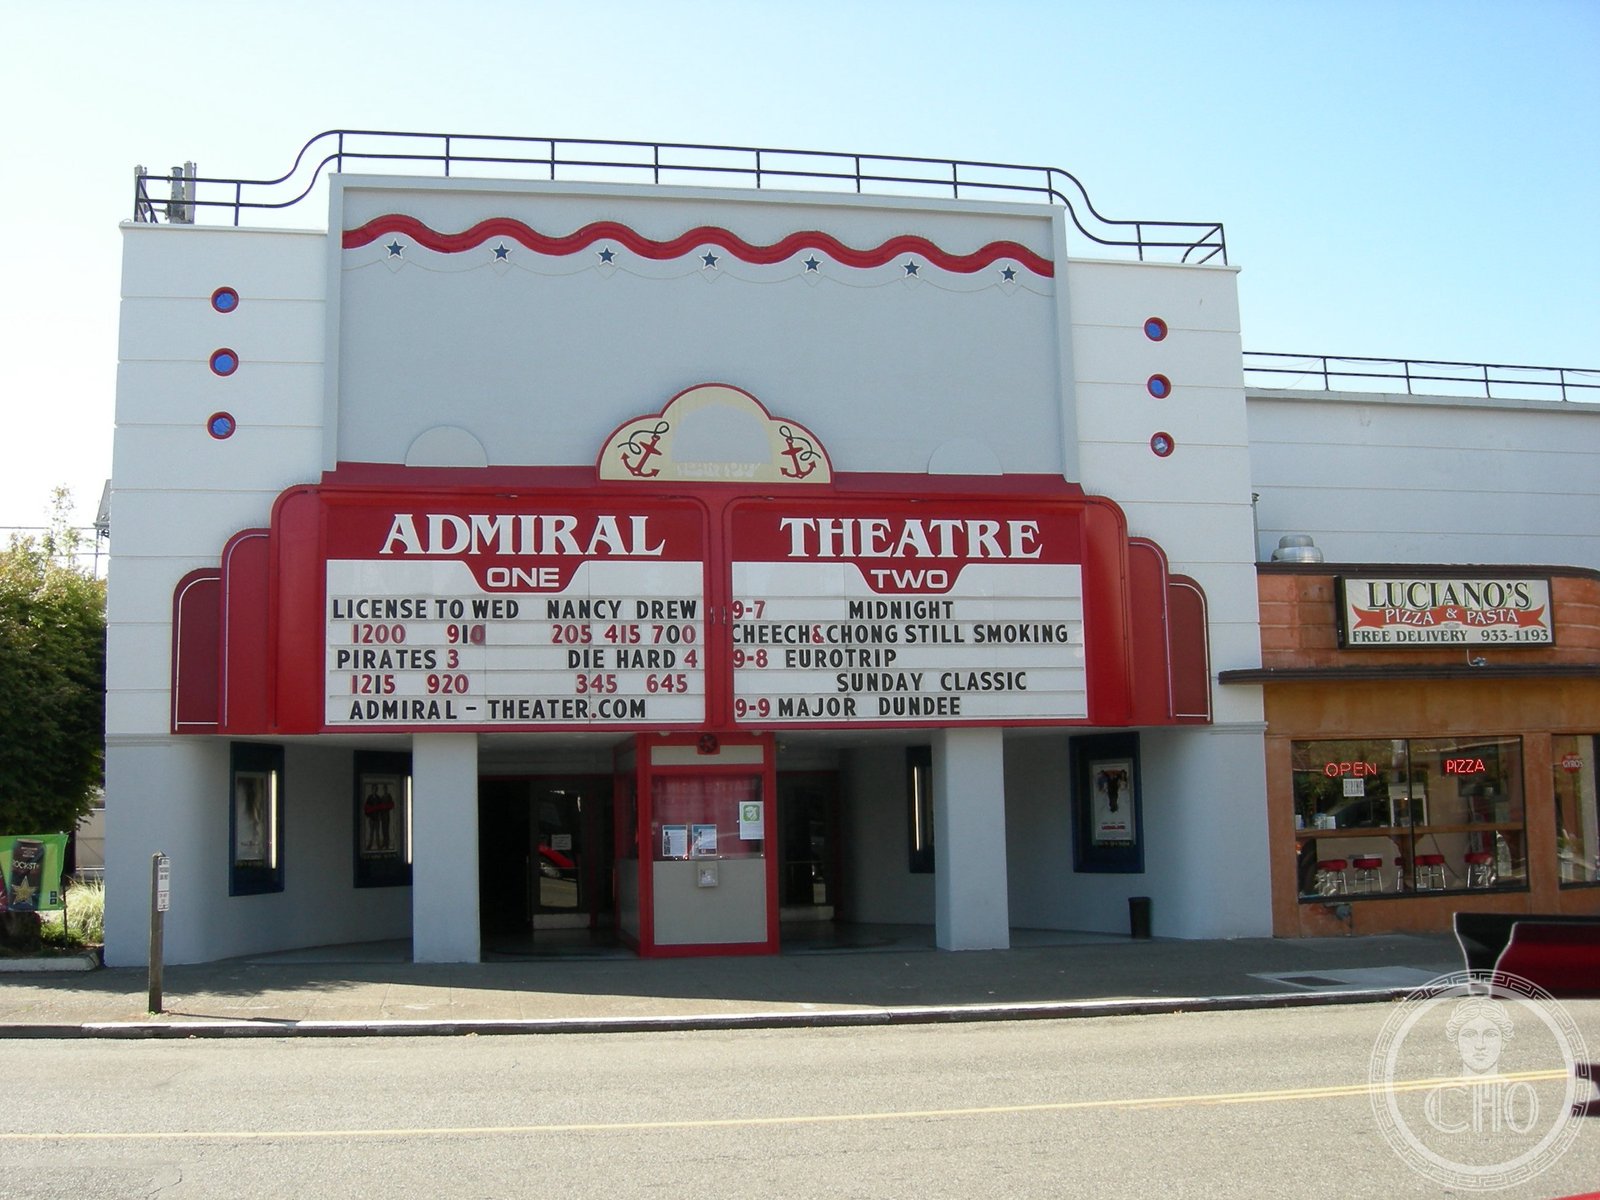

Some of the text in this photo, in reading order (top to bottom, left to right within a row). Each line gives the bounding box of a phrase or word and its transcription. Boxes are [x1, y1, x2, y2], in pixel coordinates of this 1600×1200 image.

[379, 513, 666, 556] ADMIRAL
[779, 517, 1043, 559] THEATRE
[486, 567, 560, 588] ONE
[870, 570, 948, 589] TWO
[1367, 581, 1531, 610] LUCIANO'S
[333, 599, 519, 620] LICENSE TO WED
[547, 599, 697, 620] NANCY DREW
[733, 601, 766, 619] 9-7
[849, 601, 954, 620] MIDNIGHT
[1385, 607, 1518, 625] PIZZA & PASTA
[352, 623, 485, 644] 1200 910
[552, 624, 696, 644] 205 415 700
[905, 624, 965, 644] STILL
[973, 624, 1068, 643] SMOKING
[1352, 629, 1549, 643] FREE DELIVERY 933-1193
[337, 648, 460, 669] PIRATES 3
[568, 649, 698, 669] DIE HARD 4
[733, 649, 897, 668] 9-8 EUROTRIP
[351, 674, 469, 694] 1215 920
[576, 674, 688, 694] 345 645
[837, 672, 1027, 692] SUNDAY CLASSIC
[350, 700, 457, 719] ADMIRAL
[488, 699, 646, 719] THEATER.COM
[735, 697, 961, 717] 9-9 MAJOR DUNDEE
[1324, 761, 1377, 777] OPEN
[1446, 758, 1486, 774] PIZZA
